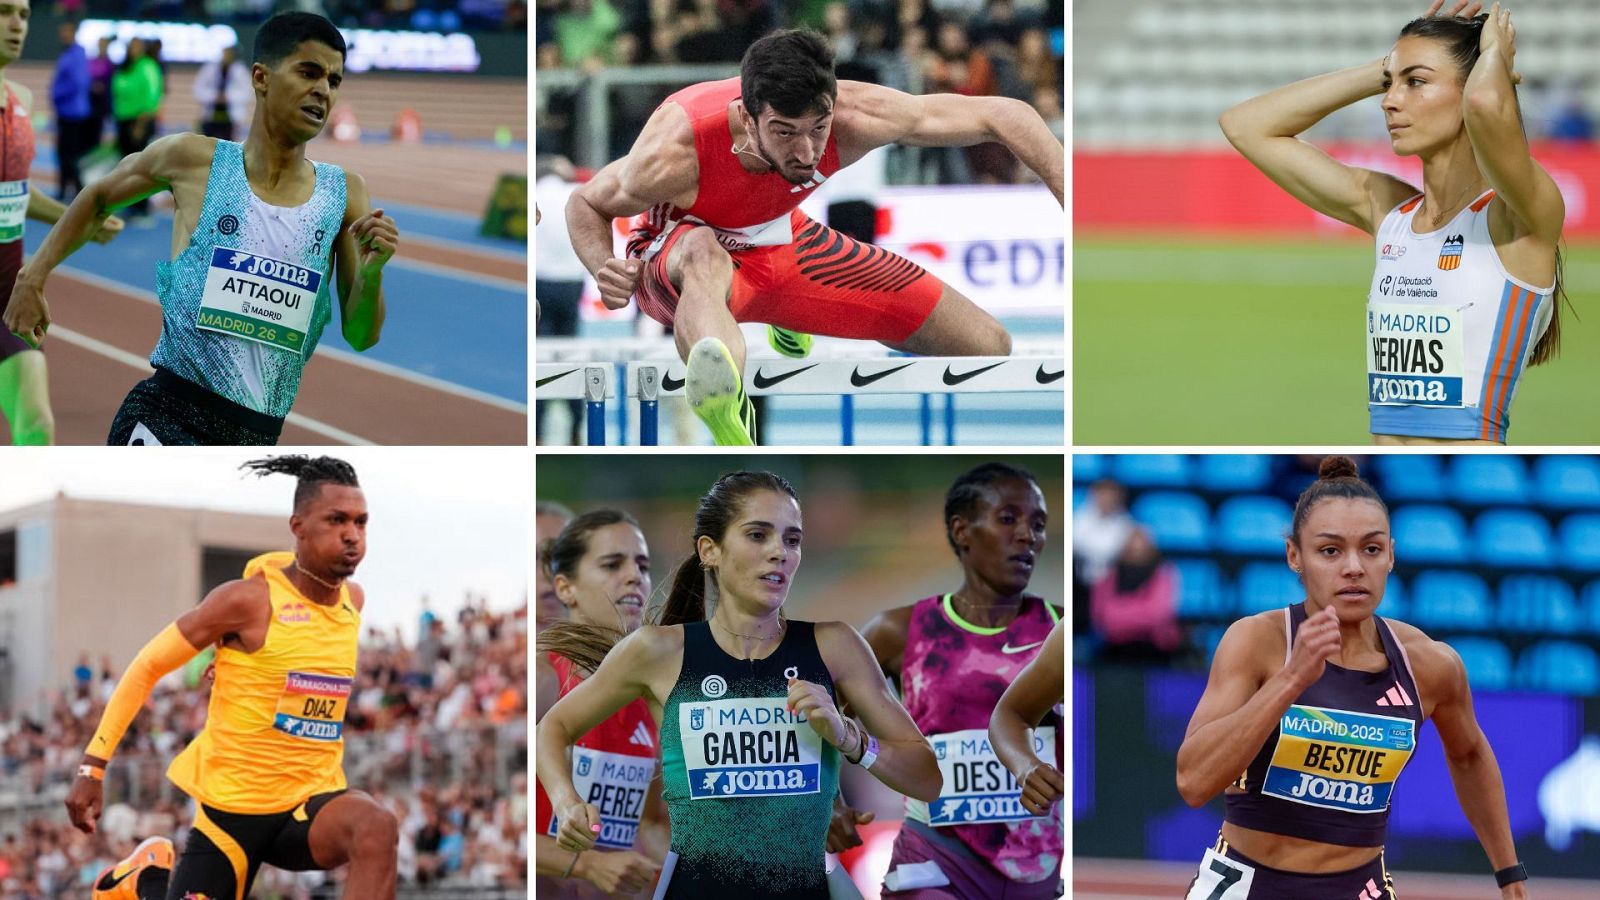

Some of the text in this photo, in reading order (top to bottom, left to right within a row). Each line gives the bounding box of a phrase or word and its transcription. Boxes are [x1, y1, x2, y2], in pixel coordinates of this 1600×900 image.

[222, 277, 301, 310] ATTAOUI
[1396, 289, 1438, 298] de València
[1398, 276, 1432, 288] Diputació
[199, 313, 277, 341] MADRID 26
[250, 306, 282, 321] MADRID
[1380, 313, 1451, 333] MADRID
[1372, 337, 1444, 374] HERVAS
[302, 697, 336, 719] DIAZ
[1284, 715, 1384, 742] MADRID 2025
[703, 730, 800, 766] GARCIA
[1303, 743, 1386, 779] BESTUE
[587, 783, 645, 820] PEREZ
[963, 797, 1031, 821] Jom
[1206, 858, 1244, 900] 7
